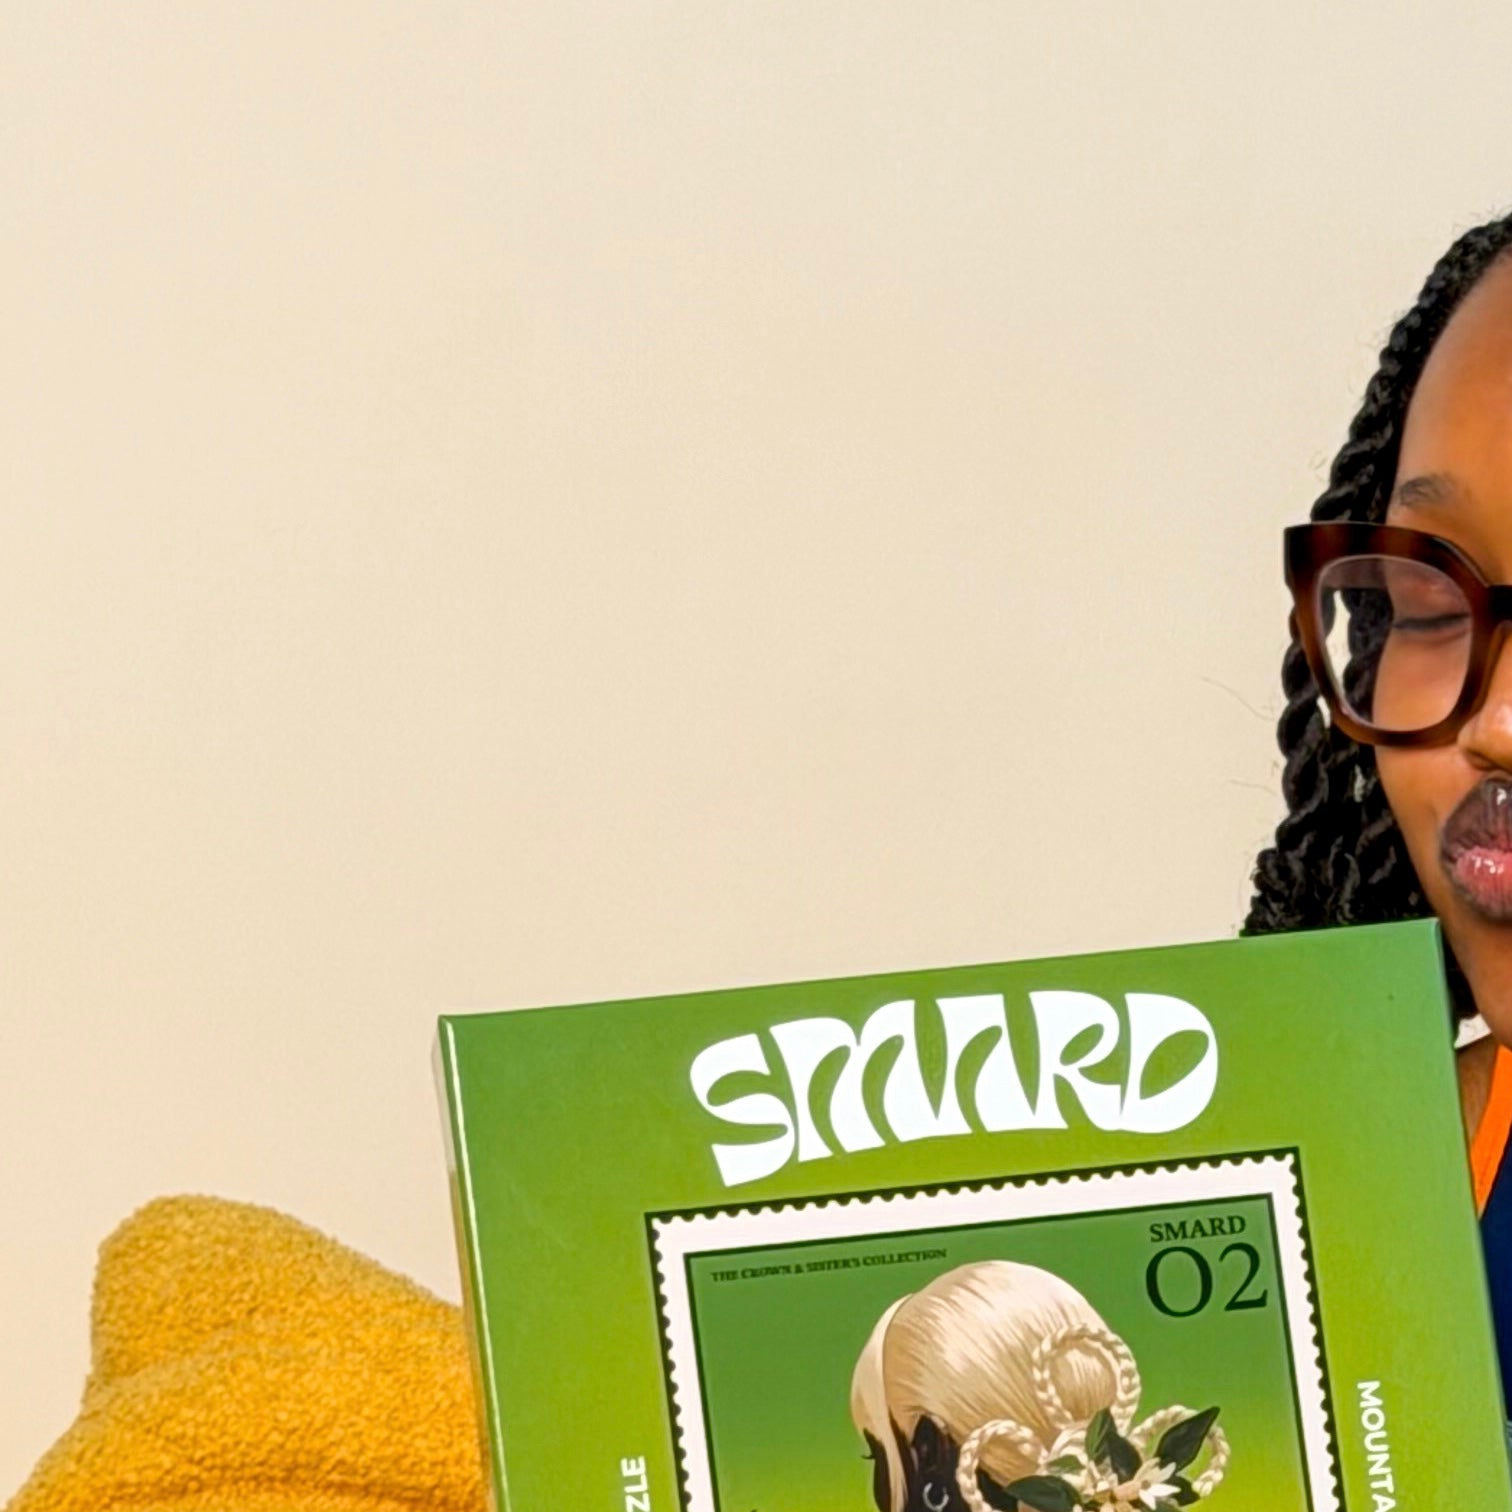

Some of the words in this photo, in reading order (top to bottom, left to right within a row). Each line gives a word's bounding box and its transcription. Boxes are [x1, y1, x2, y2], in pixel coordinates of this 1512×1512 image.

[690, 991, 1218, 1187] SMARD
[1149, 1215, 1247, 1243] SMARD
[710, 1271, 739, 1283] THE
[741, 1265, 791, 1280] CROWN
[863, 1248, 948, 1267] COLLECTION
